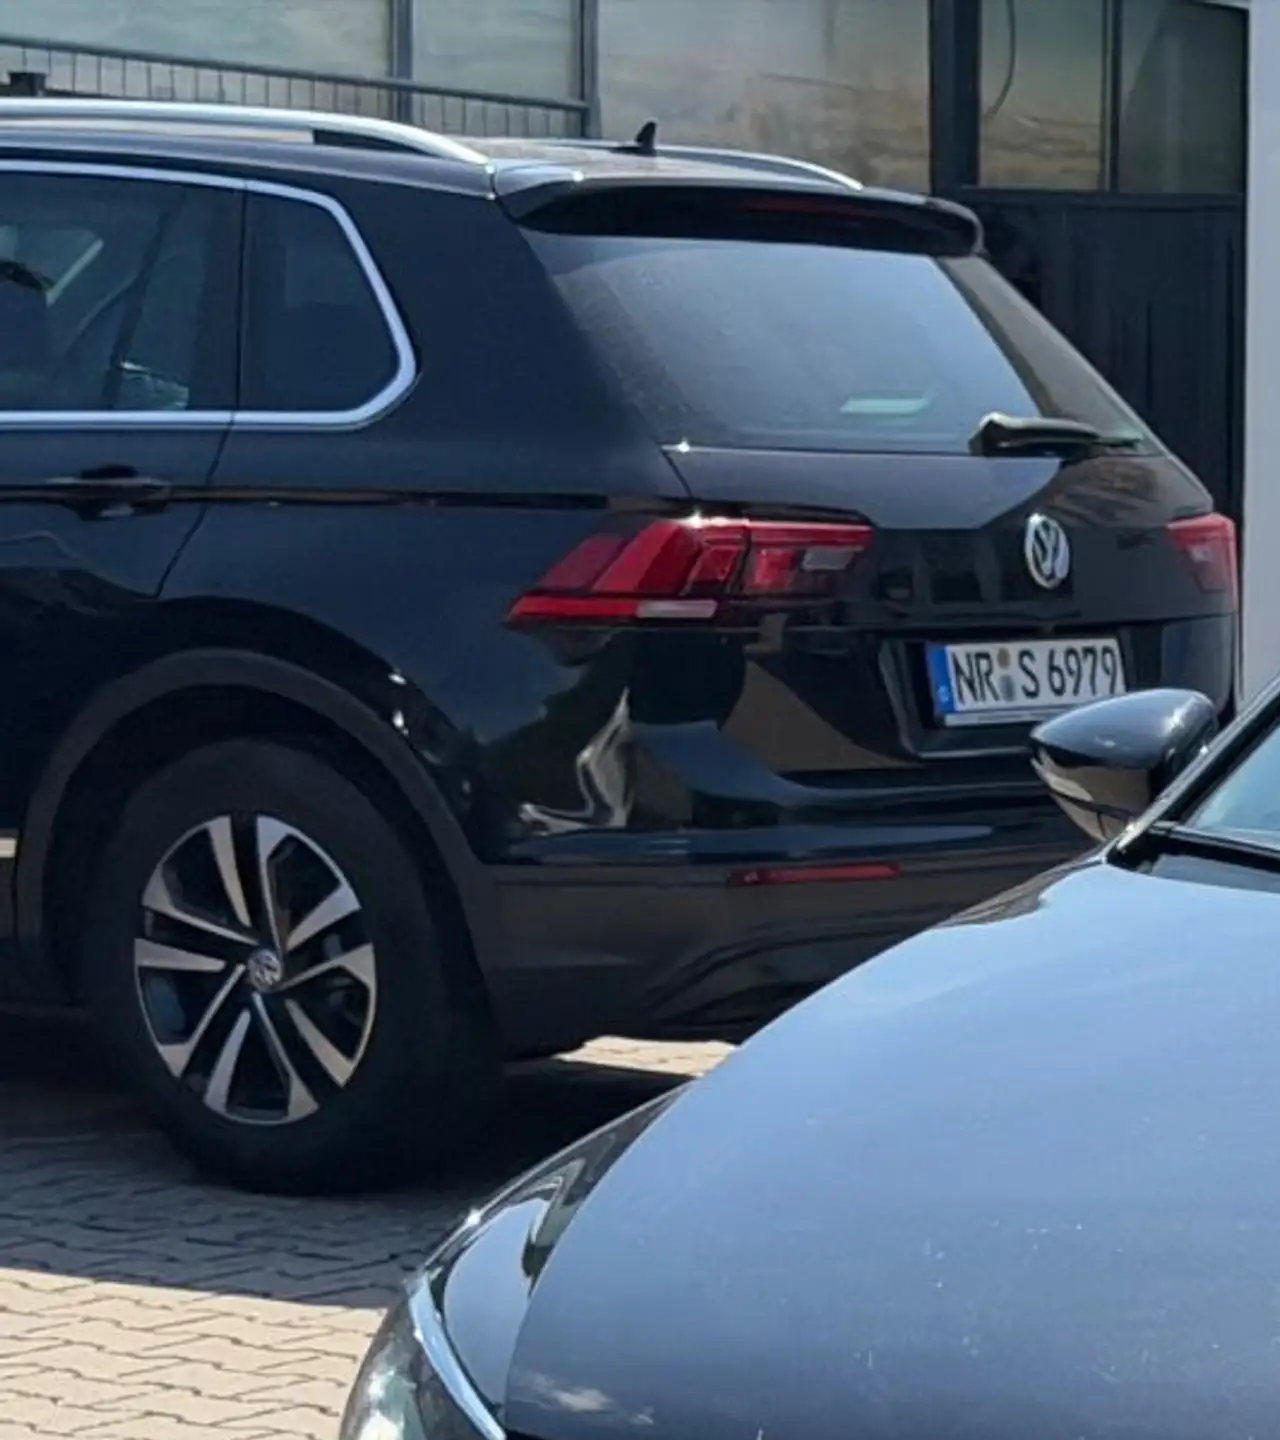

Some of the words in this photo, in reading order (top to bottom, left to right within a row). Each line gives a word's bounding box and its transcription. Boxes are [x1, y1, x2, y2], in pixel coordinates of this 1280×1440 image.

[952, 651, 1000, 704] NR
[1018, 649, 1040, 698] S
[1047, 645, 1118, 697] 6979
